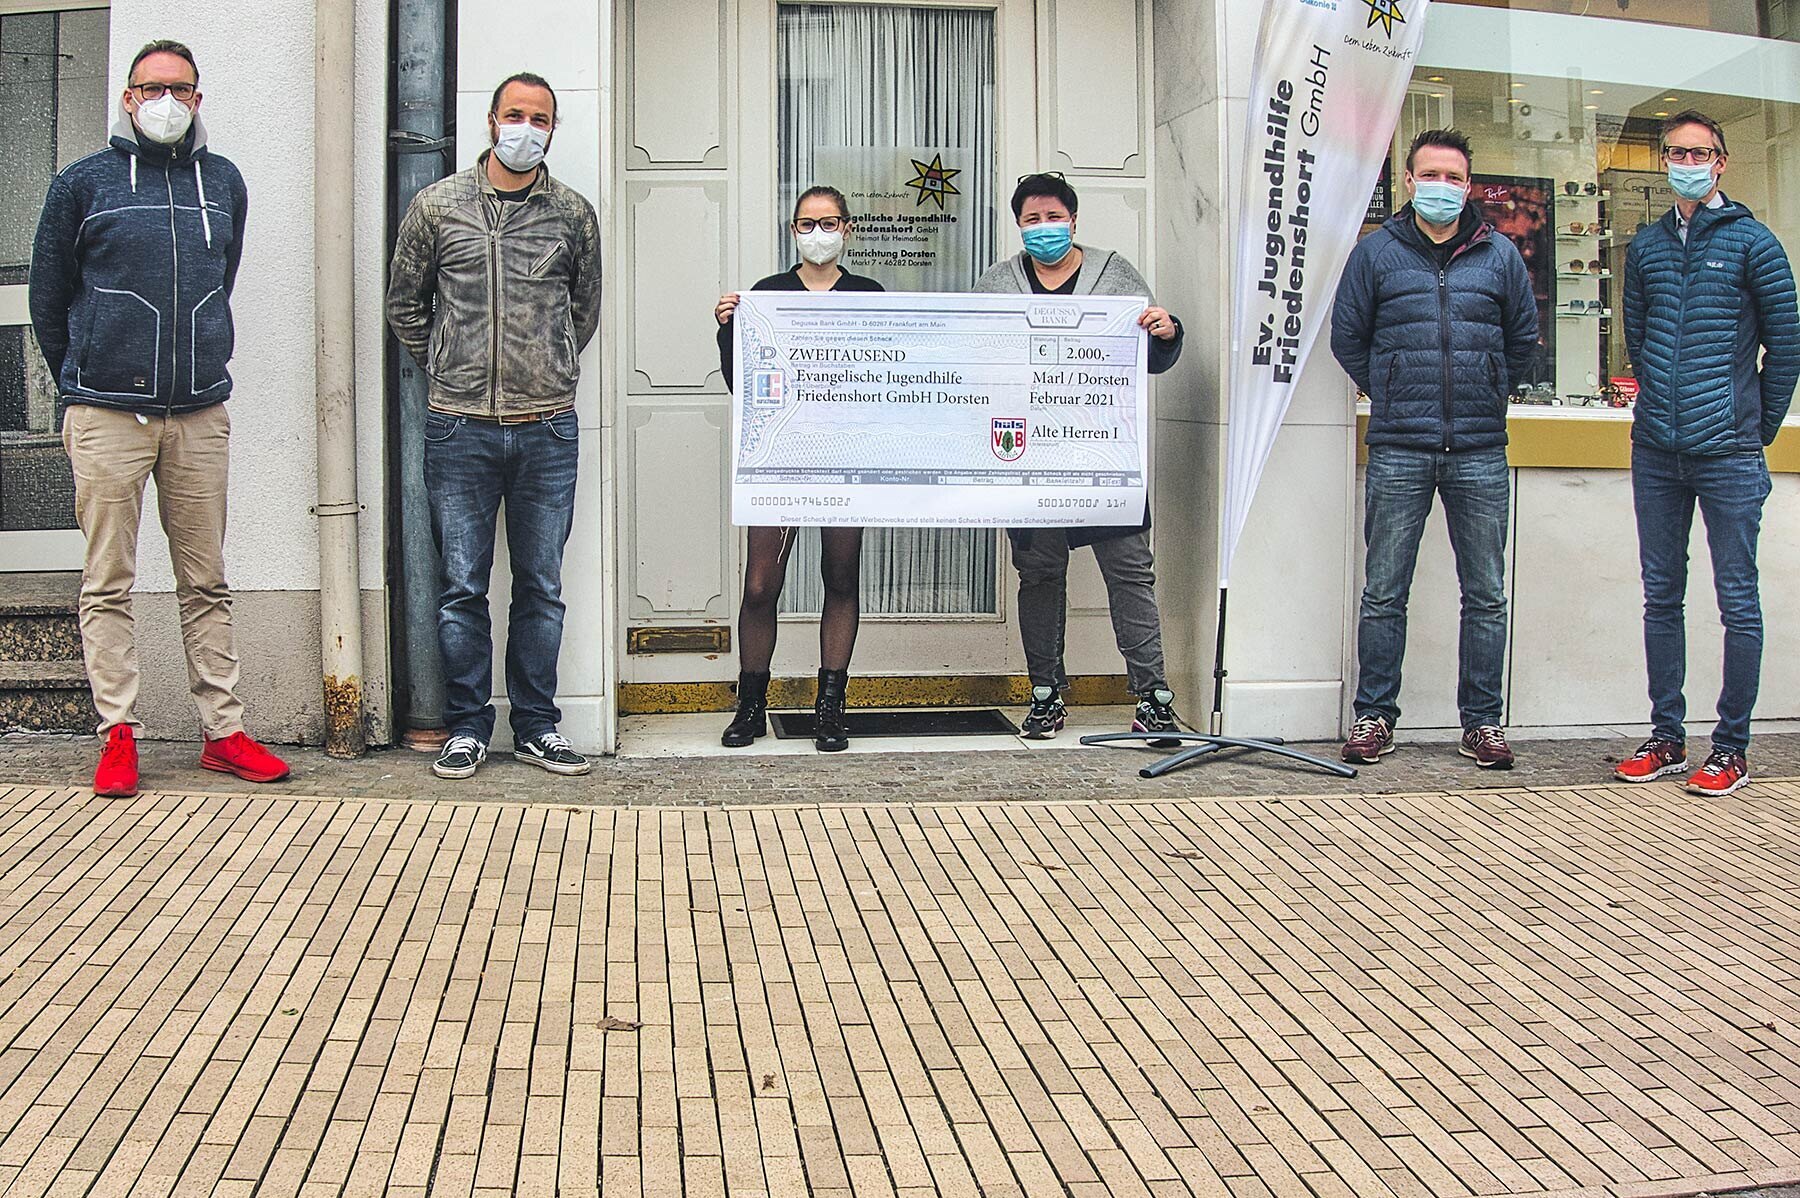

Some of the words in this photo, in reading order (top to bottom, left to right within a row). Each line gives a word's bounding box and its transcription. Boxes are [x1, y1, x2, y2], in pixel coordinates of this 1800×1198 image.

[1258, 79, 1294, 300] Jugendhilfe
[851, 213, 893, 223] gelische
[896, 213, 958, 224] Jugendhilfe
[1272, 149, 1316, 384] Friedenshort
[1300, 44, 1331, 137] GmbH
[852, 224, 913, 233] riedenshort
[855, 234, 880, 242] Heimat
[881, 234, 890, 242] für
[847, 249, 898, 259] Einrichtung
[900, 249, 936, 258] Dorsten
[1034, 307, 1077, 317] DEGUSSA
[1041, 316, 1068, 325] BANK
[1252, 313, 1275, 366] Ev.
[789, 348, 906, 362] ZWEITAUSEND
[1038, 344, 1047, 357] €
[1066, 347, 1111, 361] 2.000,-
[796, 369, 883, 386] Evangelische
[886, 371, 963, 387] Jugendhilfe
[1032, 371, 1064, 384] Marl
[1078, 372, 1129, 386] Dorsten
[796, 389, 883, 403] Friedenshort
[886, 390, 932, 404] GmbH
[936, 391, 990, 405] Dorsten
[1029, 391, 1081, 405] Februar
[1084, 393, 1115, 406] 2021
[994, 420, 1024, 429] hüls
[1031, 425, 1059, 438] Alte
[1063, 426, 1109, 439] Herren
[1113, 427, 1118, 439] I
